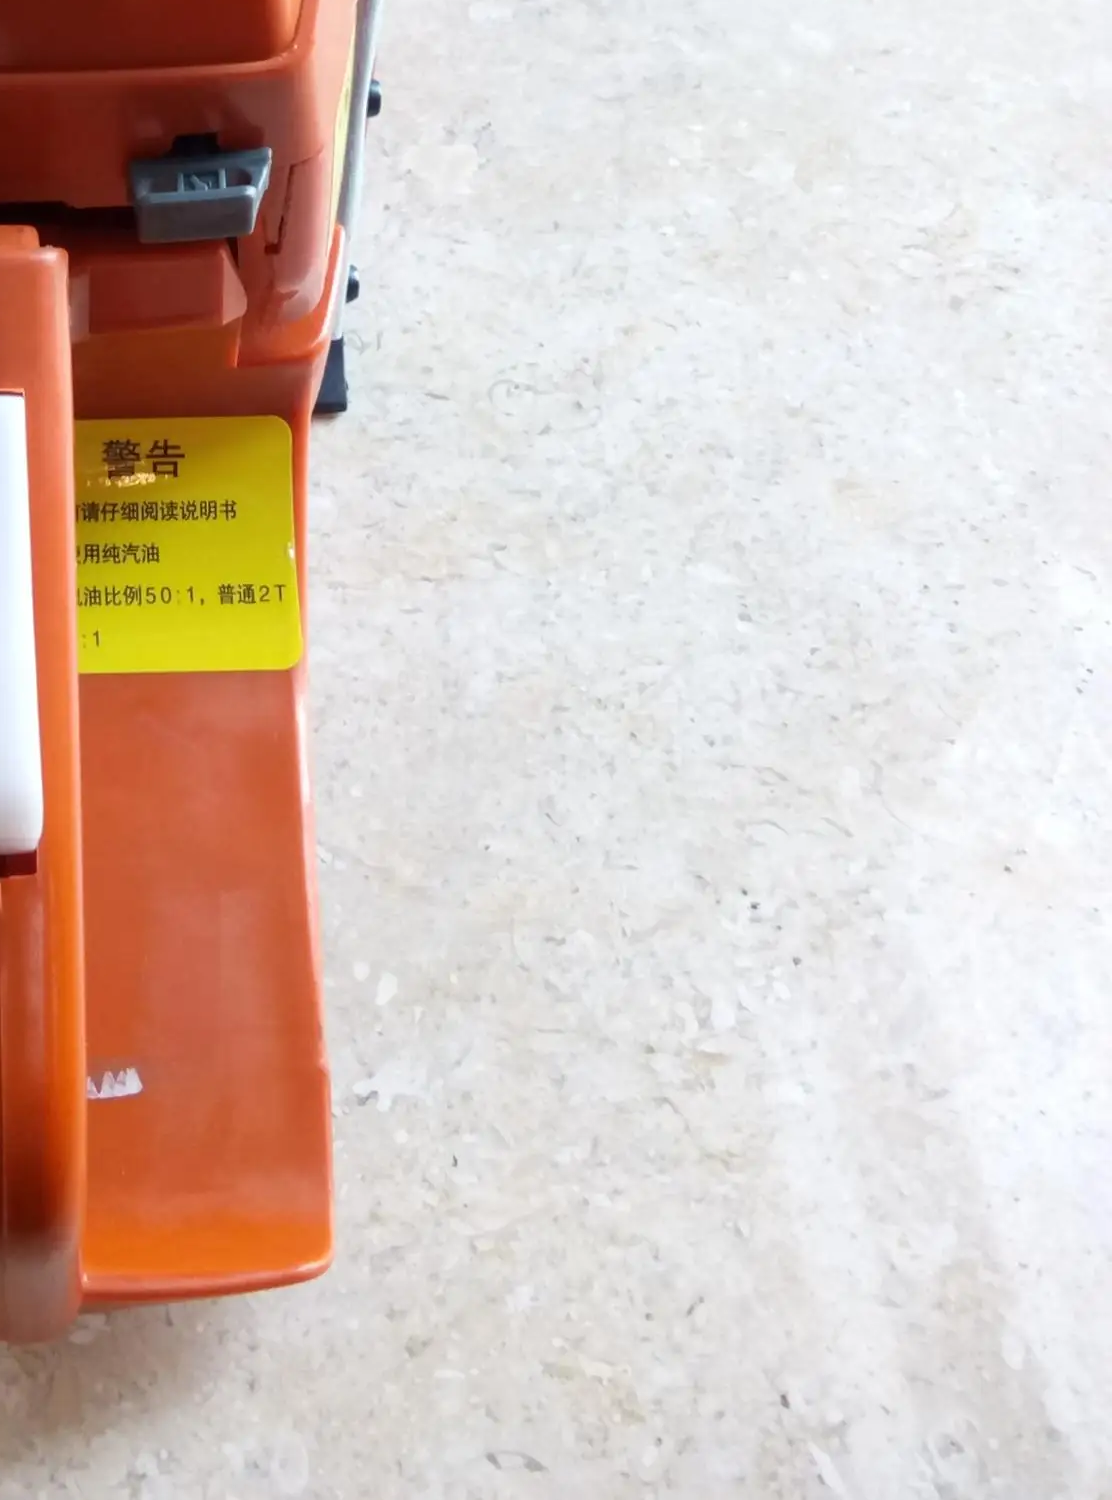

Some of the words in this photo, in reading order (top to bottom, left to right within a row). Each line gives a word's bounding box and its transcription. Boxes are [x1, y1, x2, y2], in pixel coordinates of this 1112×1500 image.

[101, 438, 186, 480] 警告
[76, 500, 238, 522] 请仔细阅读说明书
